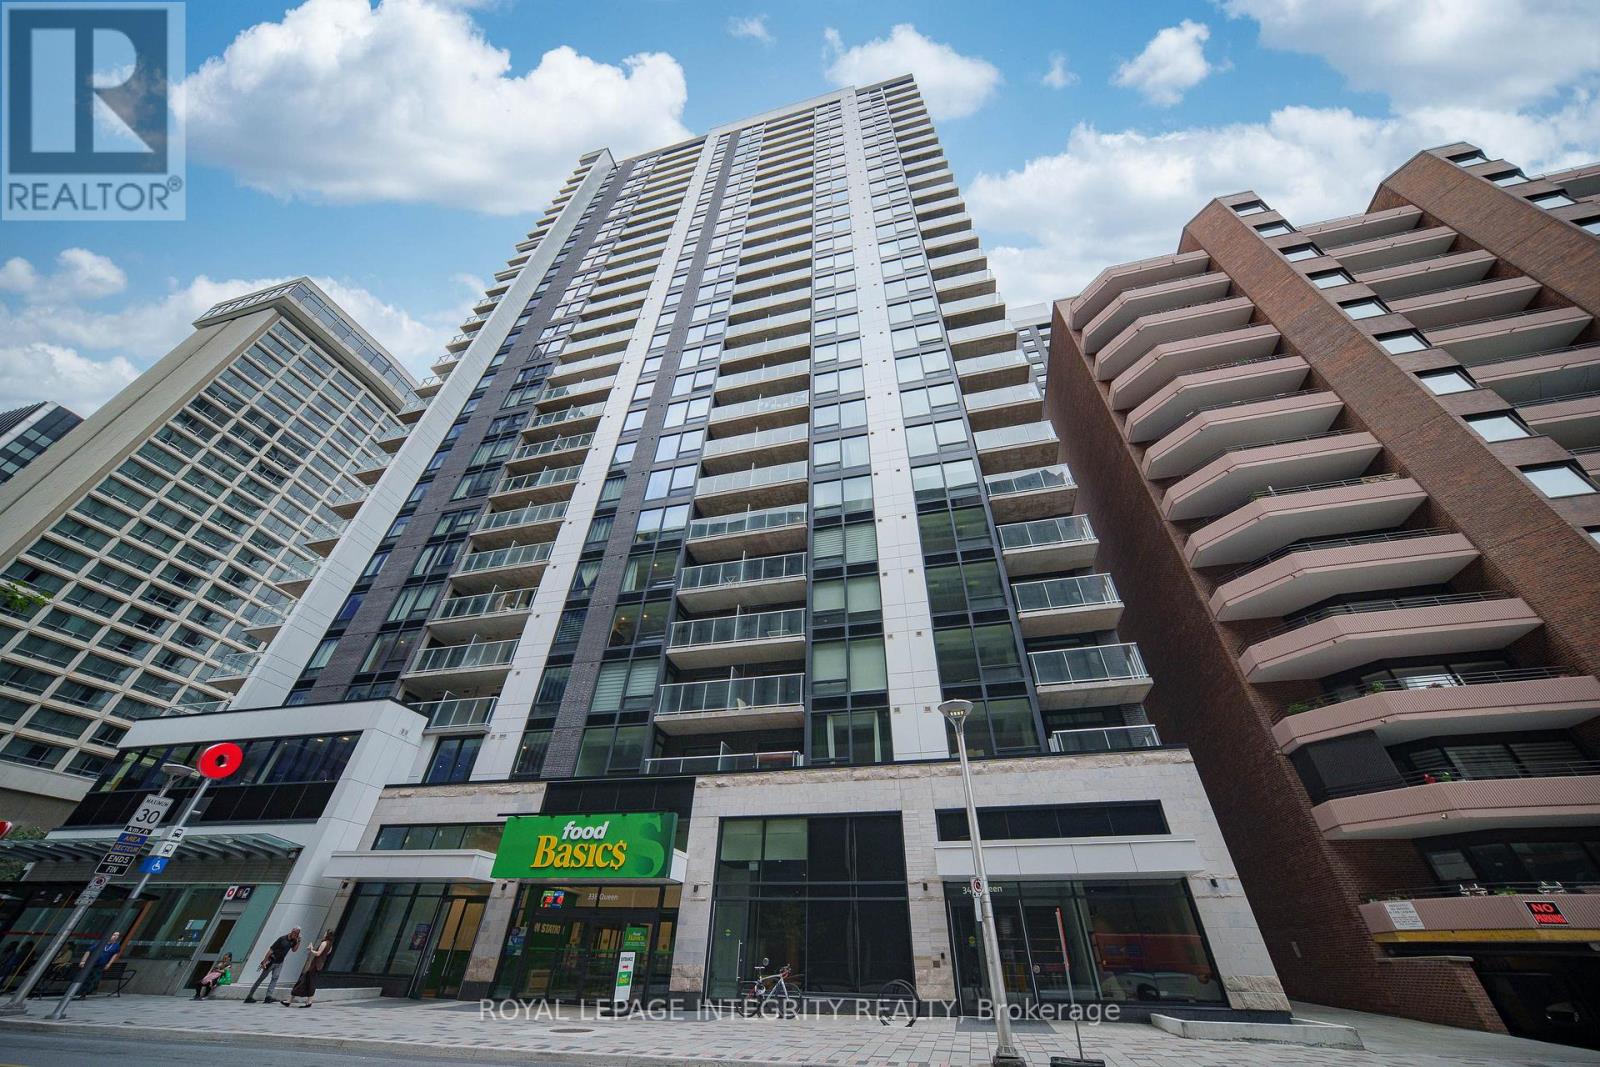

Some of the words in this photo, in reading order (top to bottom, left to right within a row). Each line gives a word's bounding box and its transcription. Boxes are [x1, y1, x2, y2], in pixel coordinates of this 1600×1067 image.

[136, 808, 160, 824] 30
[127, 827, 149, 835] km/h
[562, 820, 609, 840] food
[107, 854, 130, 863] ENDS
[105, 865, 119, 874] FIN
[599, 893, 618, 901] Queen
[1530, 903, 1555, 913] NO
